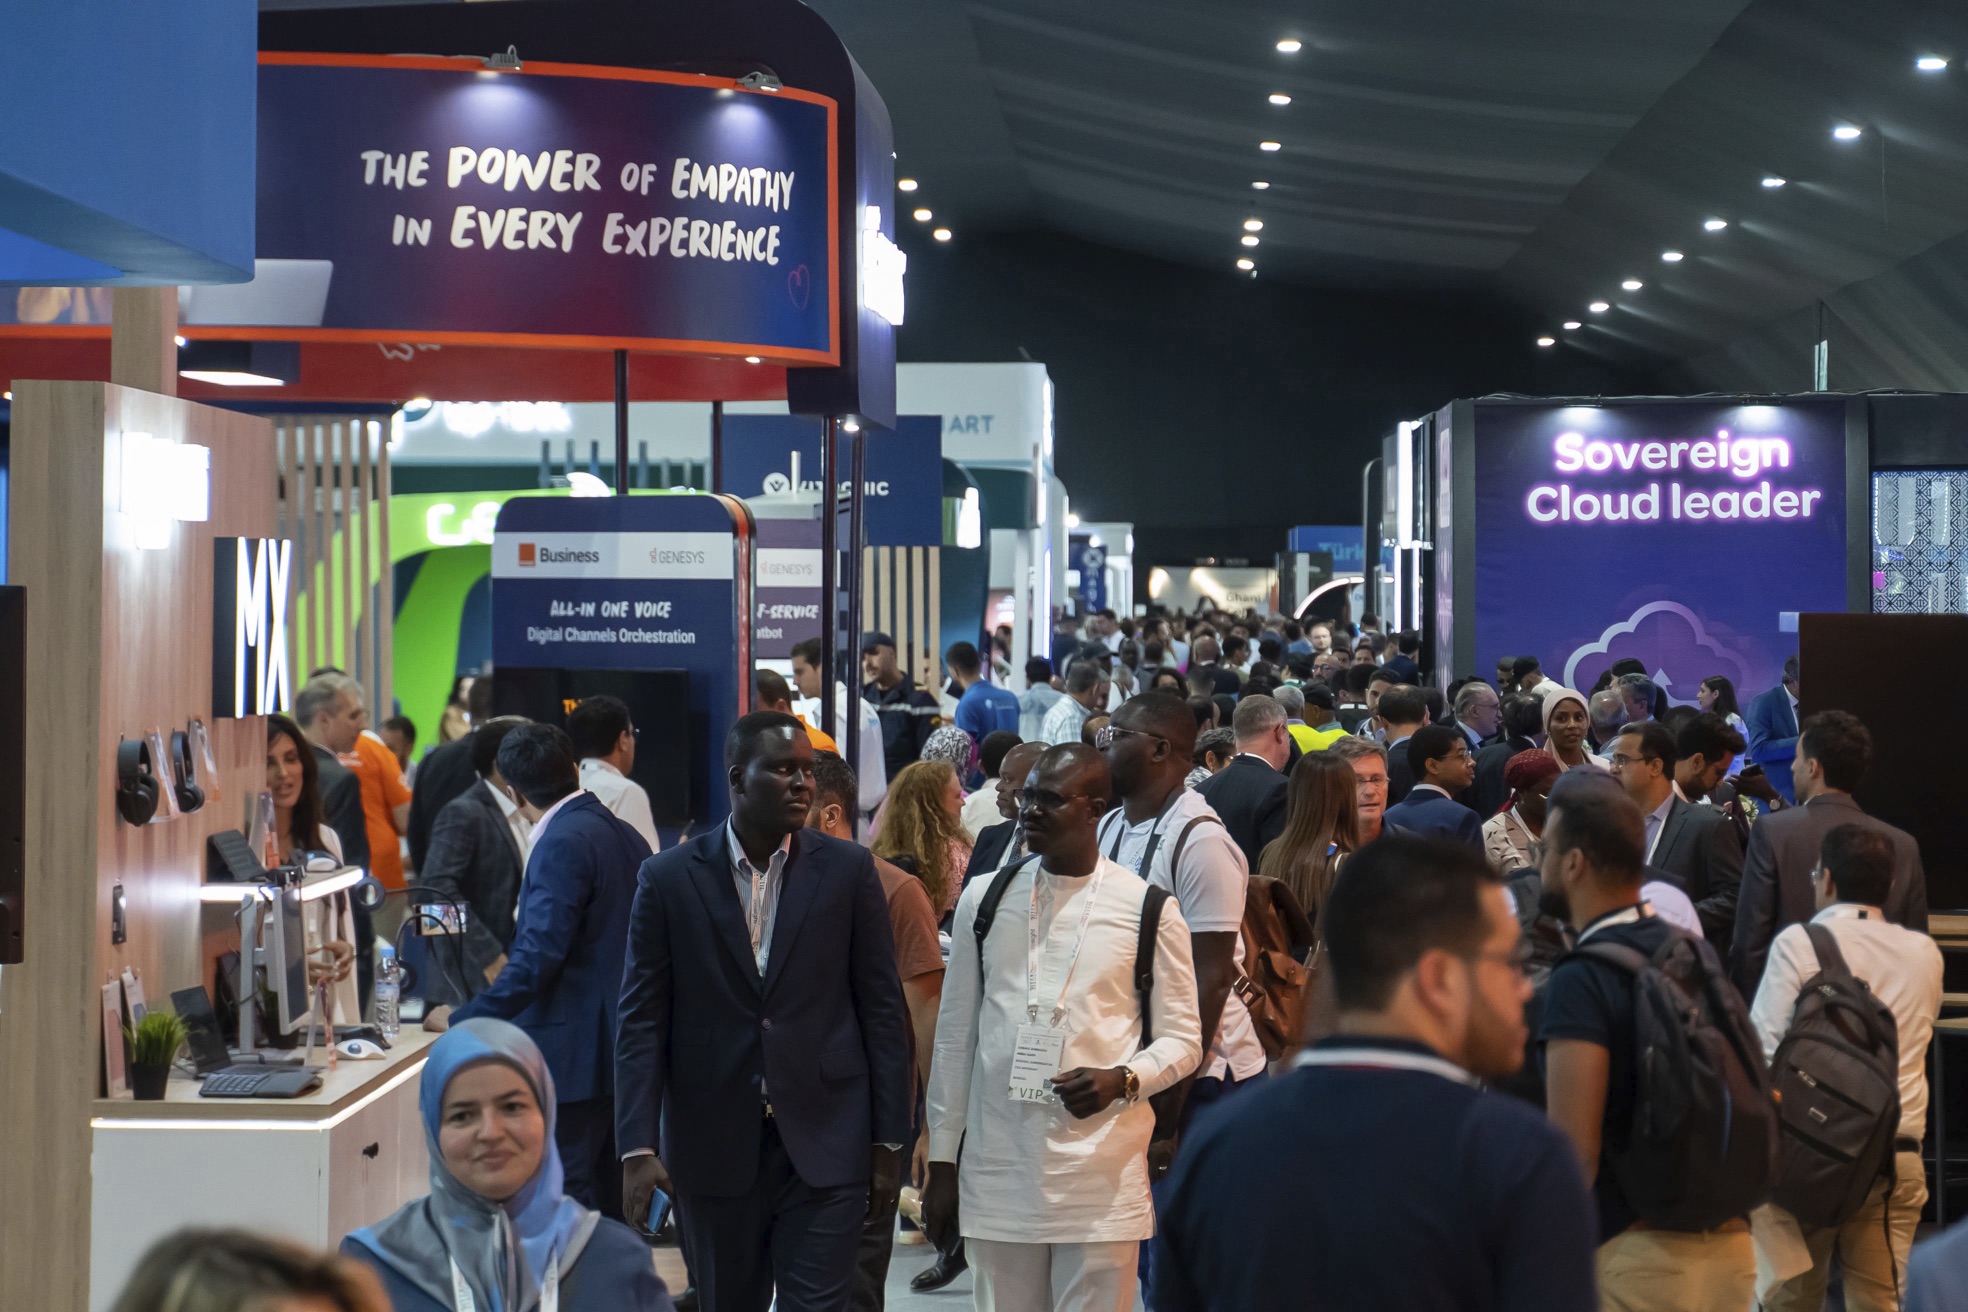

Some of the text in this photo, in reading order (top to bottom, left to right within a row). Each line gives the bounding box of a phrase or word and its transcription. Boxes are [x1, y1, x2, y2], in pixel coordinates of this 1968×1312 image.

[361, 146, 795, 213] THE POWER OF EMPATHY
[392, 205, 781, 266] IN EVERY EXPERIENCE
[942, 414, 994, 434] ART
[1554, 430, 1790, 477] Sovereign
[1527, 482, 1821, 521] Cloud leader
[540, 547, 600, 563] Business
[659, 551, 705, 564] GENESYS
[769, 563, 813, 575] GENESYS
[550, 600, 672, 618] ALL-IN ONE VOICE
[235, 536, 292, 719] MX
[527, 626, 695, 645] Digital Channels Orchestration
[1020, 1087, 1043, 1100] VIP
